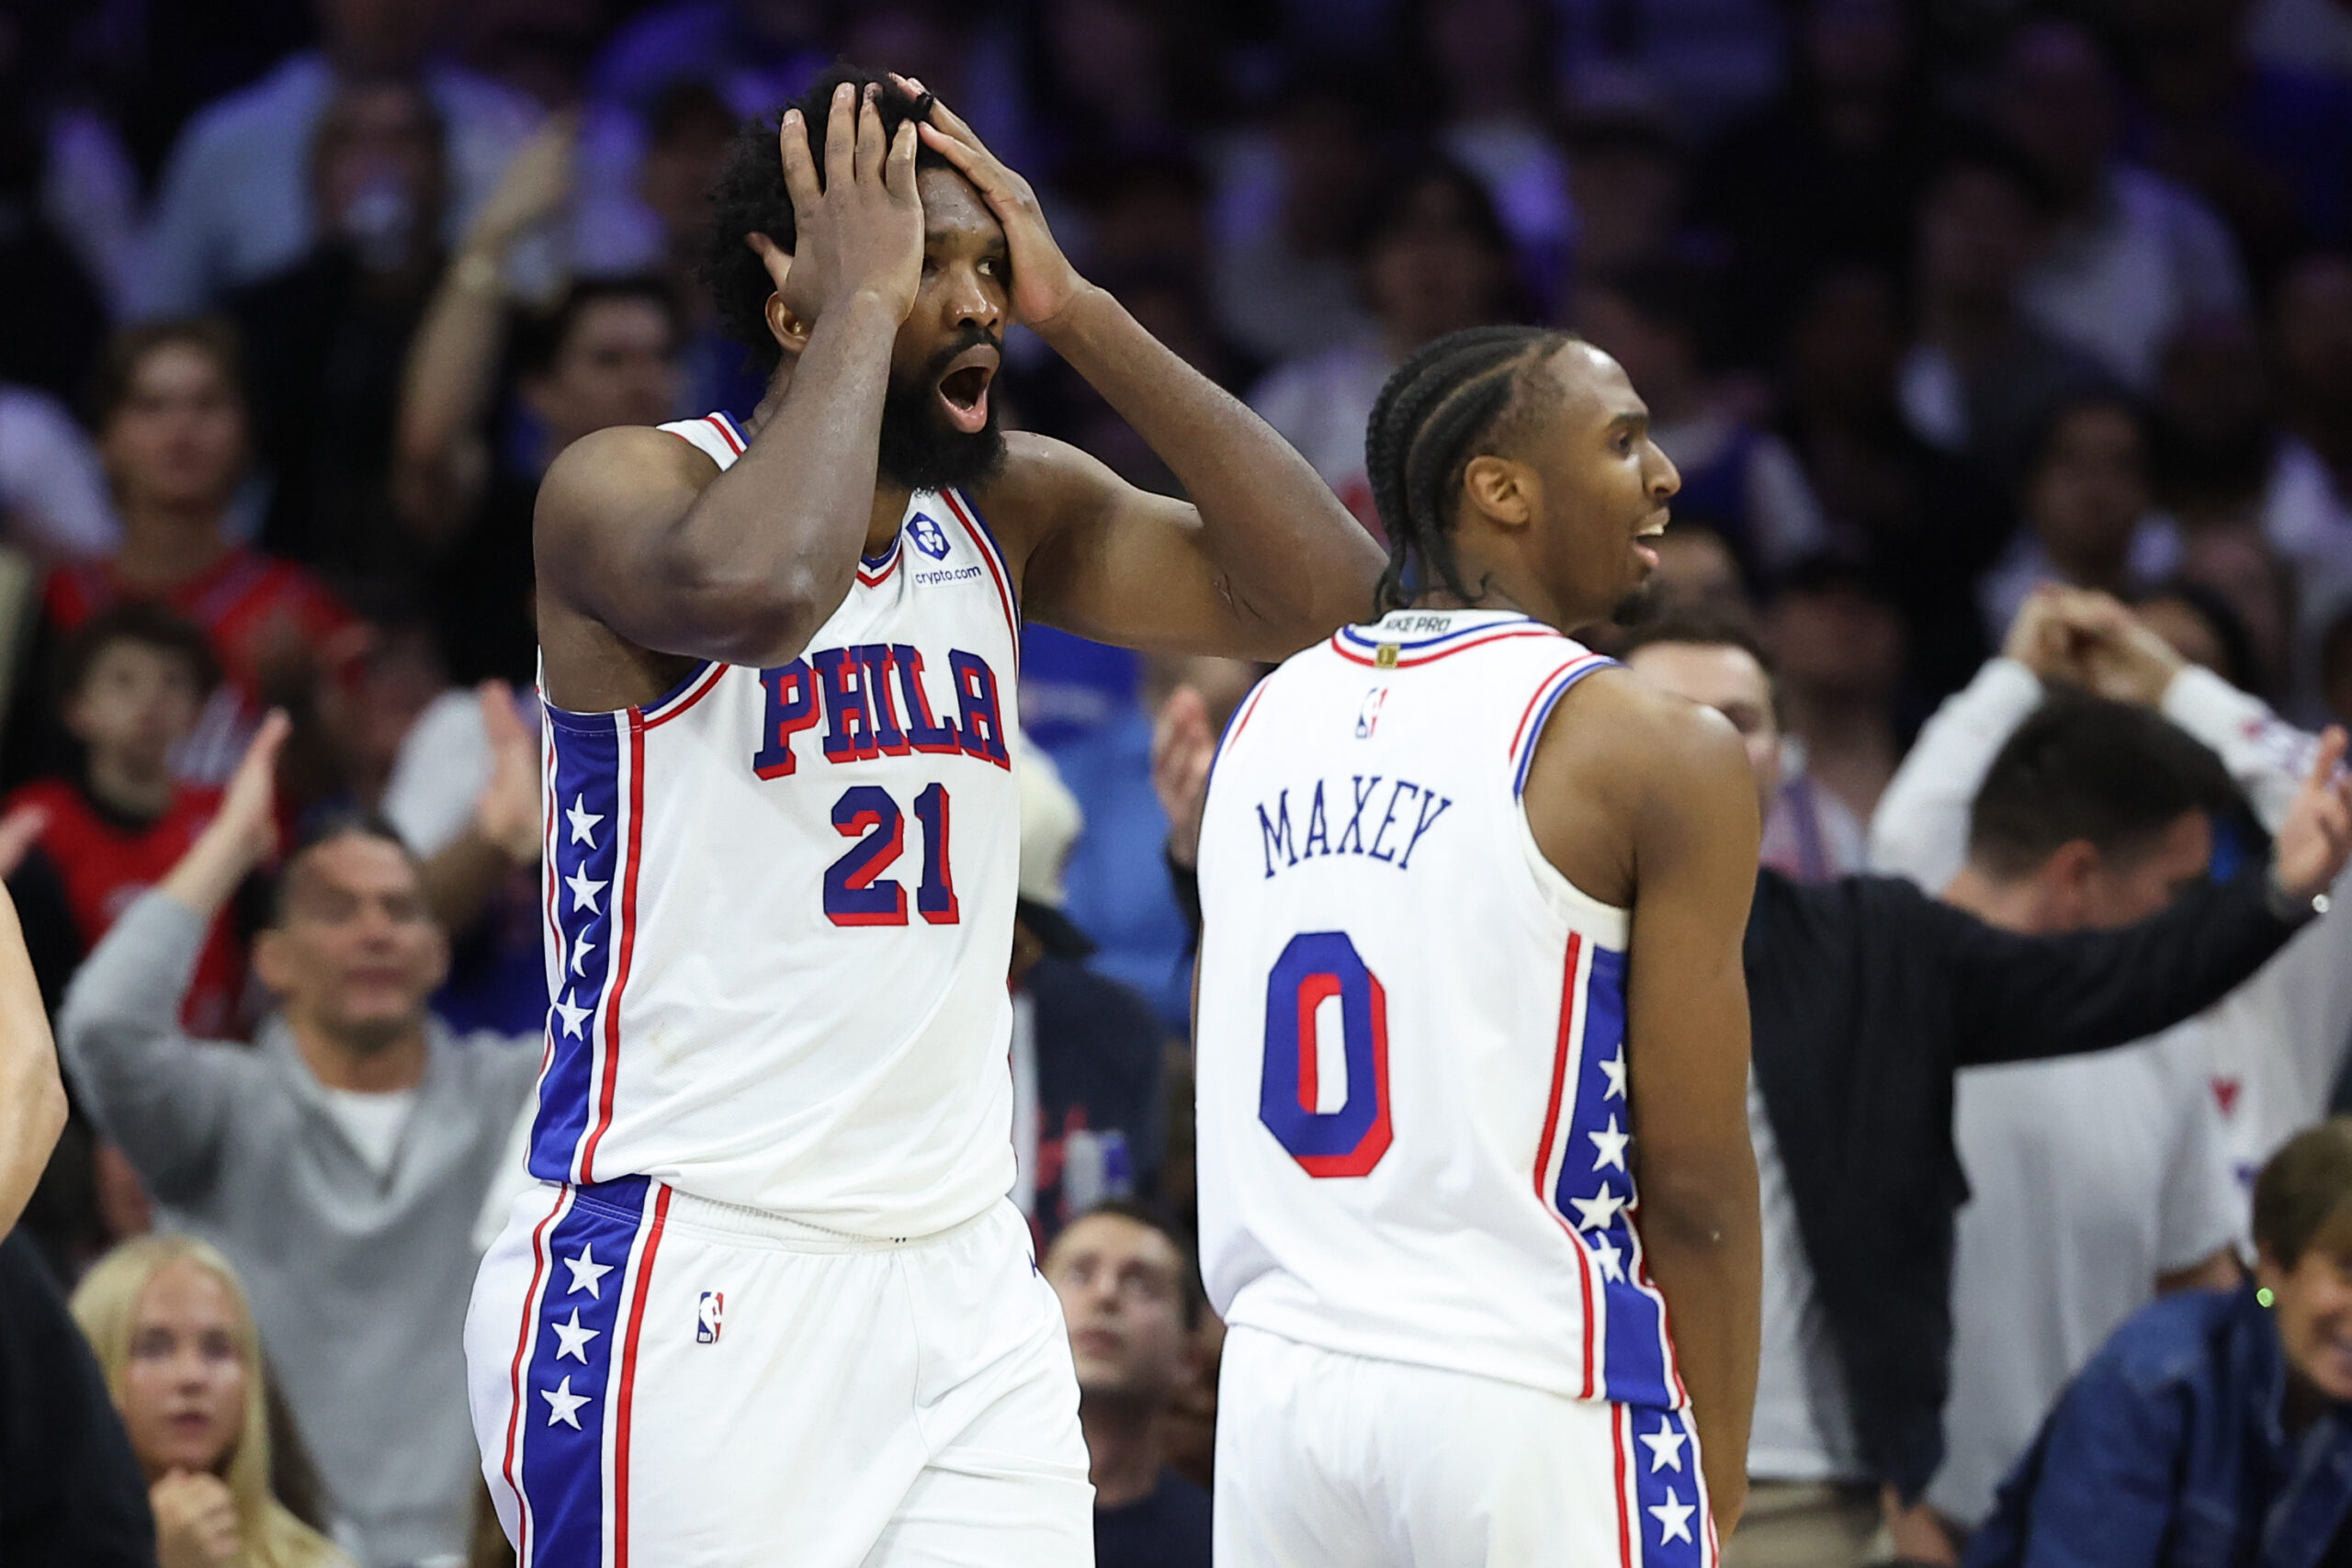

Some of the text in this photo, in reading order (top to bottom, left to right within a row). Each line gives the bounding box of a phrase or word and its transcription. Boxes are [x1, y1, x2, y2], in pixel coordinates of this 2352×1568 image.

[915, 566, 982, 584] crypto.com
[1414, 616, 1452, 632] PRO
[753, 643, 1012, 781] PHILA
[822, 782, 960, 927] 21
[1256, 775, 1453, 879] MAXEY
[1258, 930, 1395, 1179] 0
